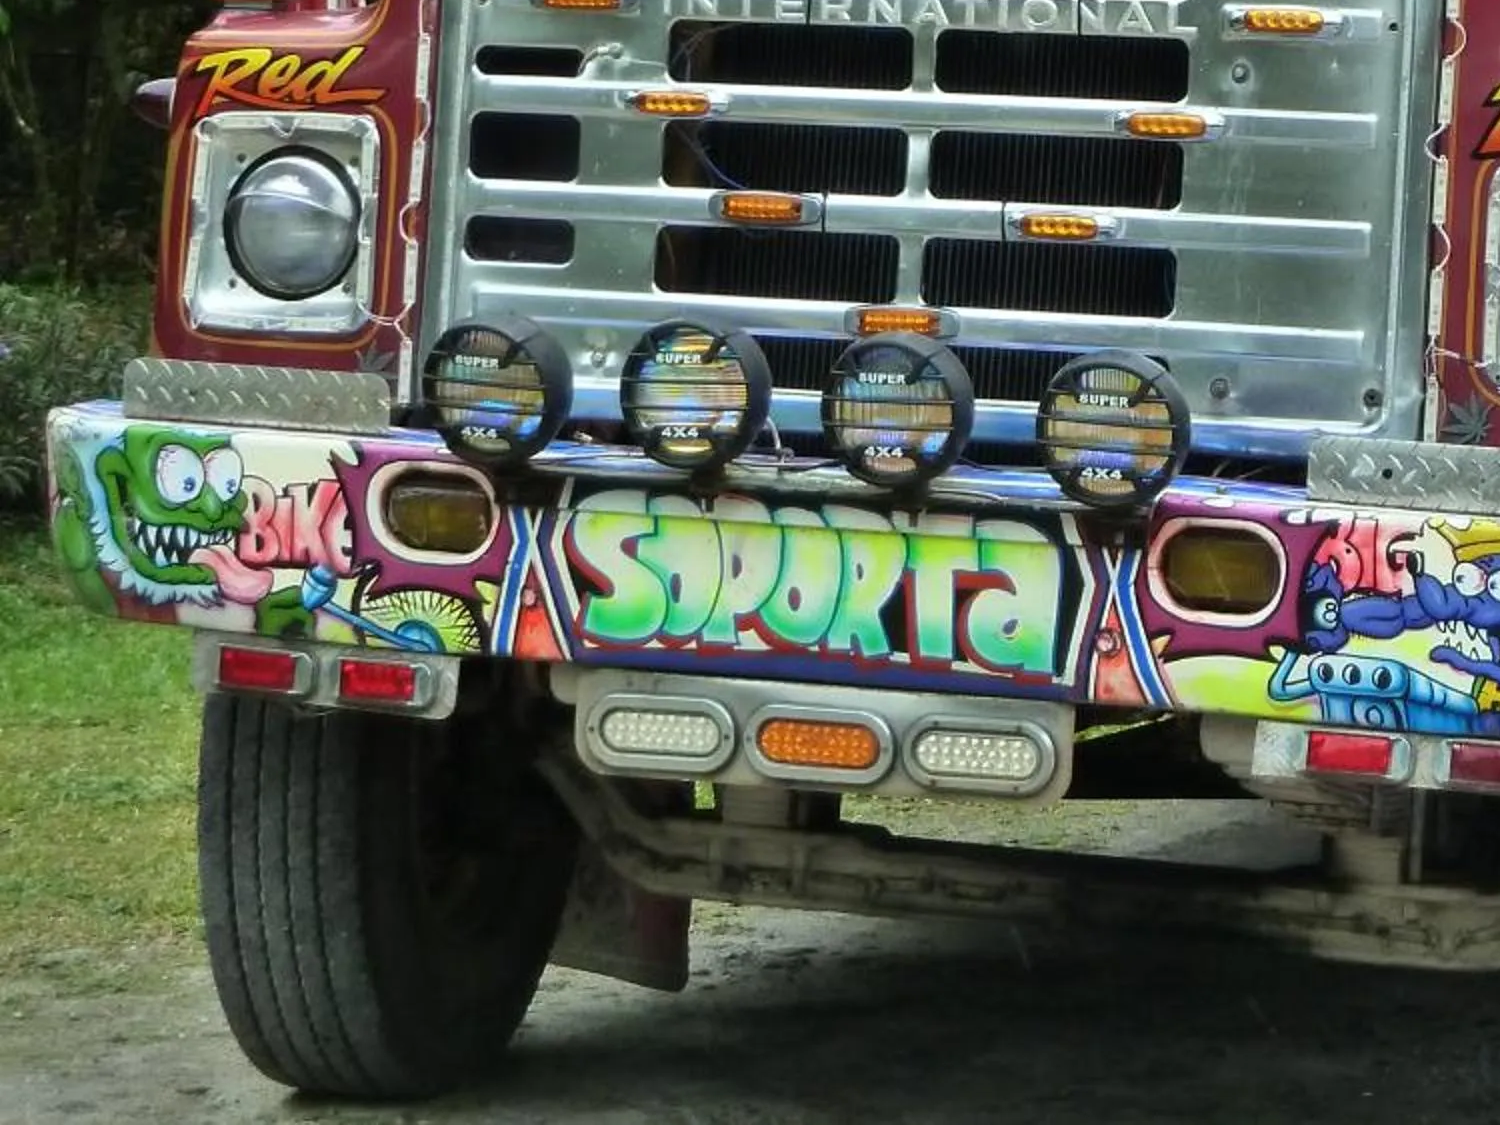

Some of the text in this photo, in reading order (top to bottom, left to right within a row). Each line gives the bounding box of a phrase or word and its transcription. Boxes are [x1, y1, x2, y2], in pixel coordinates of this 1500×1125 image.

[194, 47, 387, 118] Red
[455, 354, 500, 369] SUPER
[655, 352, 702, 365] SUPER
[859, 372, 906, 384] SUPER
[1079, 393, 1129, 408] SUPER
[460, 425, 499, 440] 4X4
[661, 426, 699, 438] 4X4
[863, 446, 904, 458] 4X4
[1081, 466, 1123, 480] 4X4
[234, 475, 354, 577] BIKE
